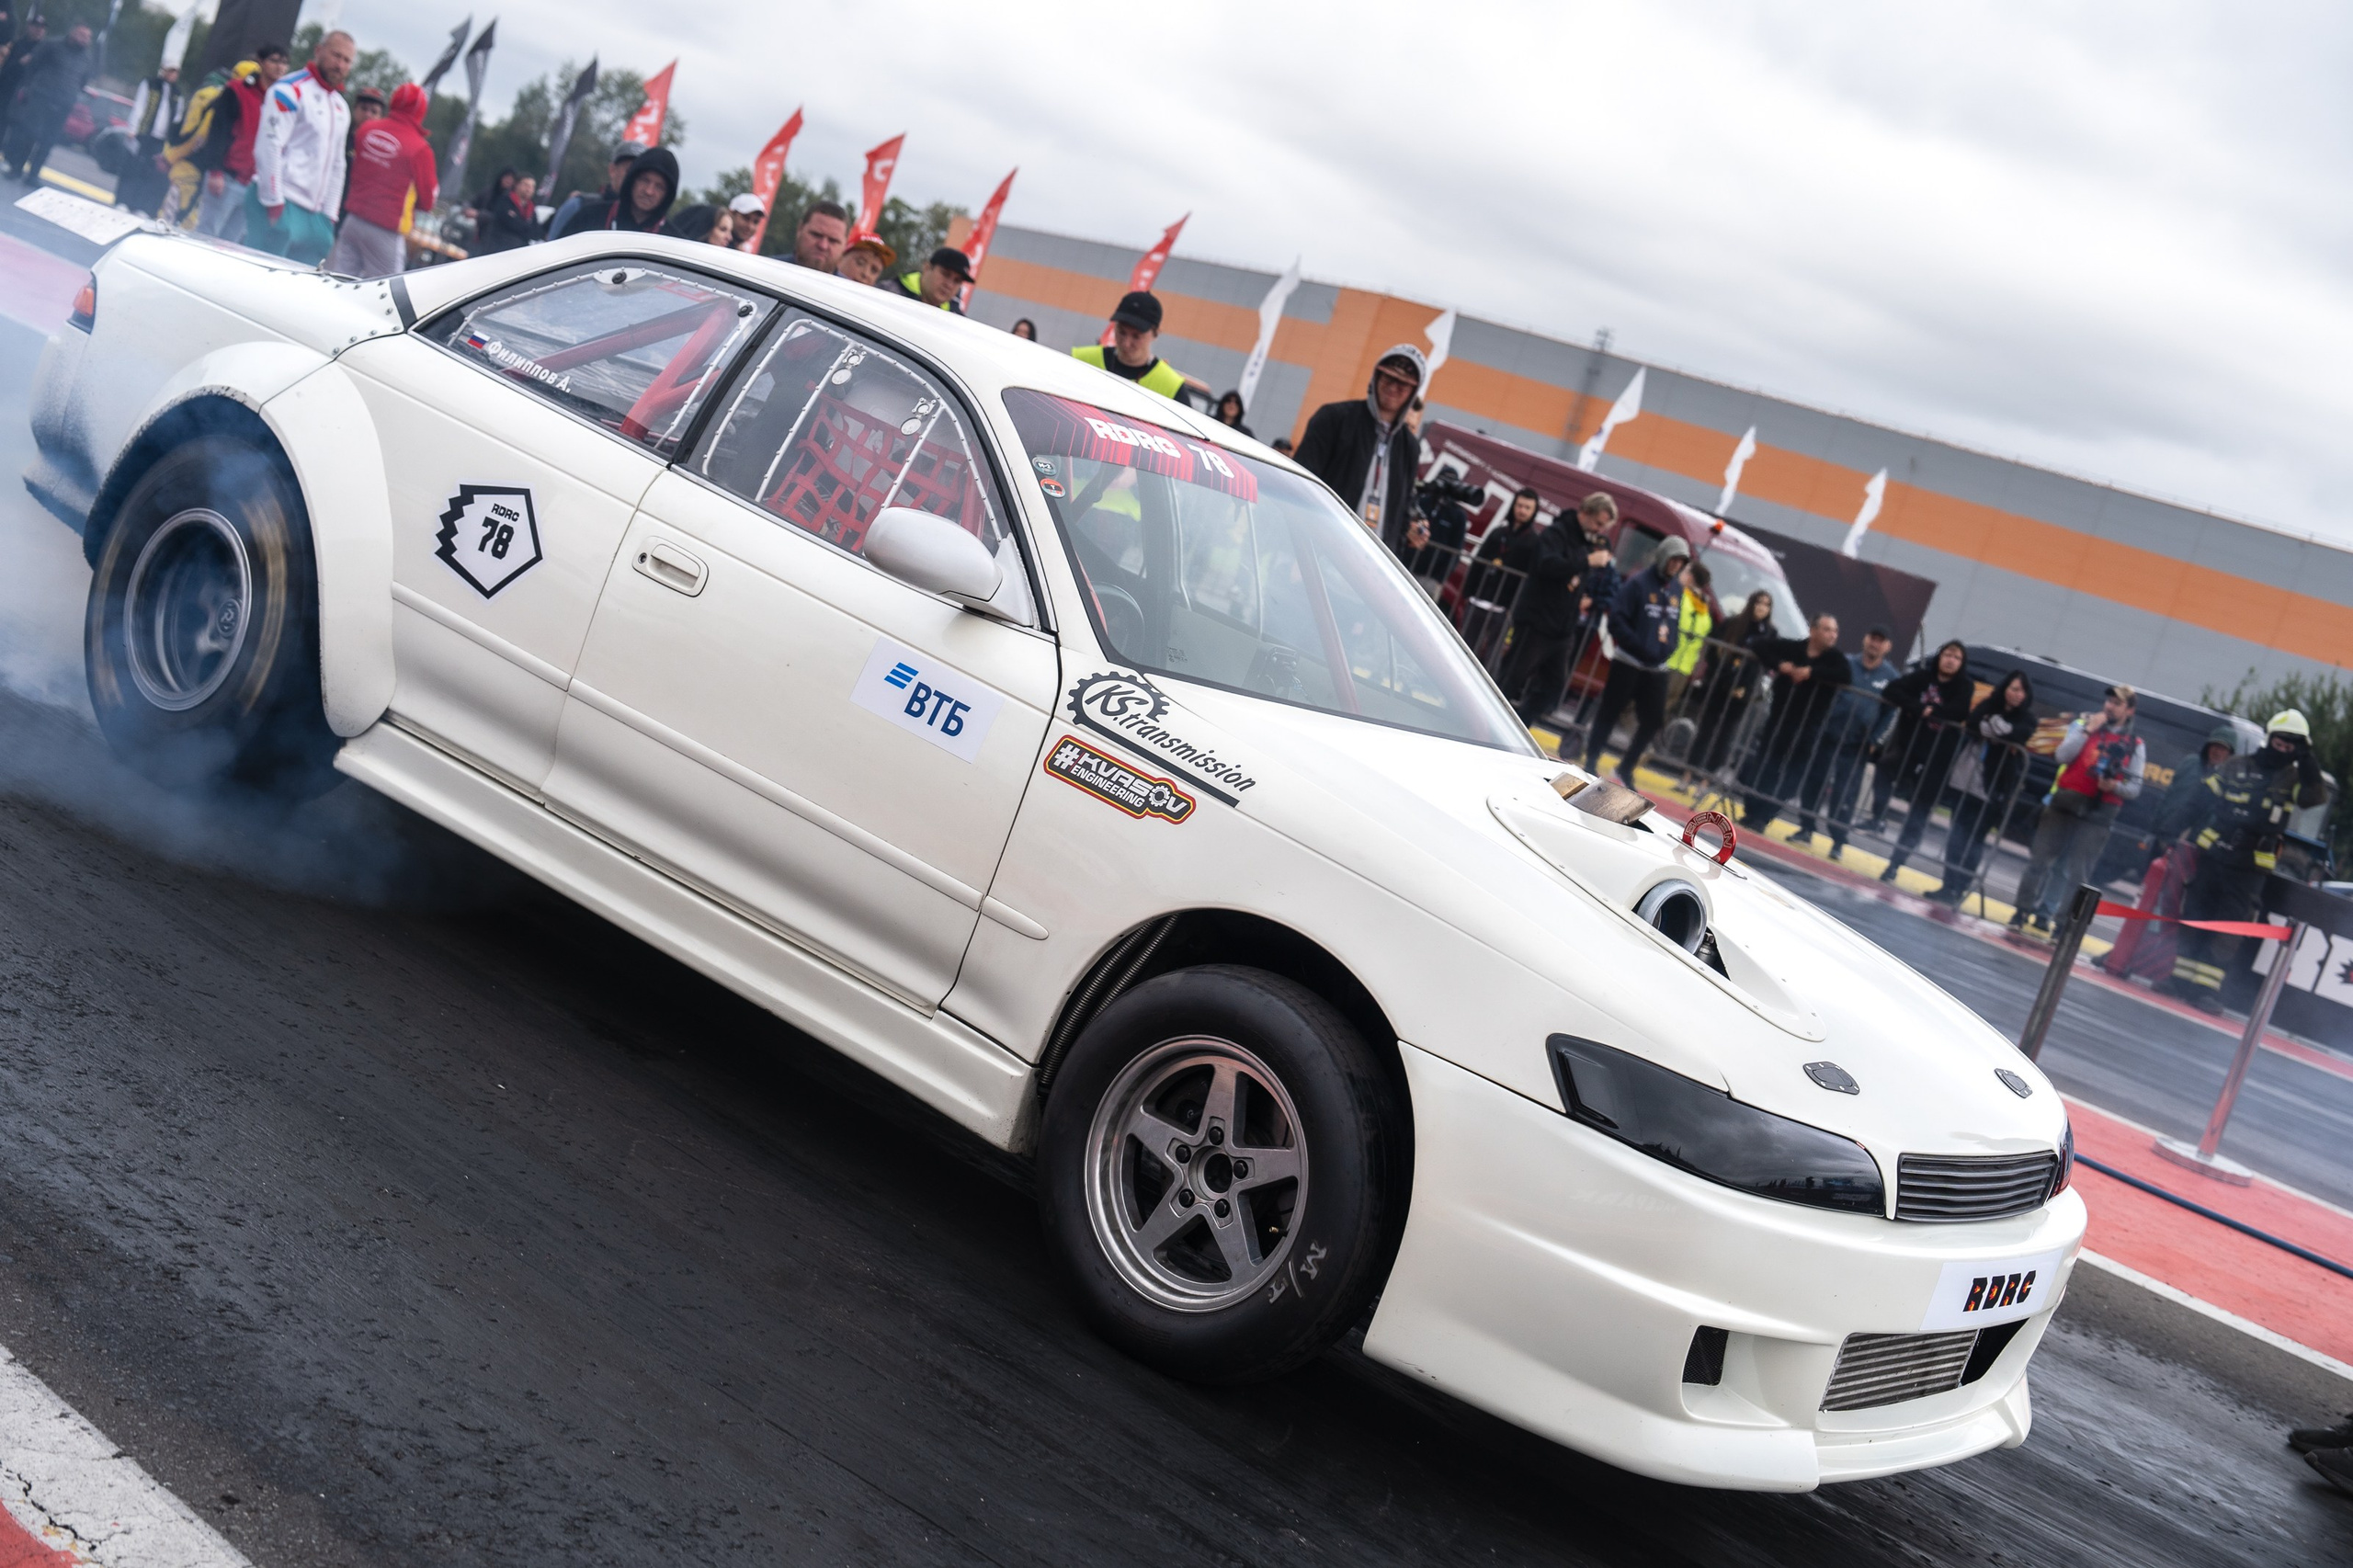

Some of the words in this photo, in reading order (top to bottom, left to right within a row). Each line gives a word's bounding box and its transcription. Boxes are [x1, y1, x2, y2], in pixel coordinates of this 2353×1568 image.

[487, 340, 558, 384] Филиппов
[1084, 416, 1182, 459] RDRC
[1187, 443, 1235, 479] 78
[491, 503, 520, 522] RDRC
[478, 516, 515, 560] 78
[904, 681, 972, 737] ВТБ
[1070, 764, 1146, 808] ENGINEERING
[1962, 1269, 2036, 1312] RDRC
